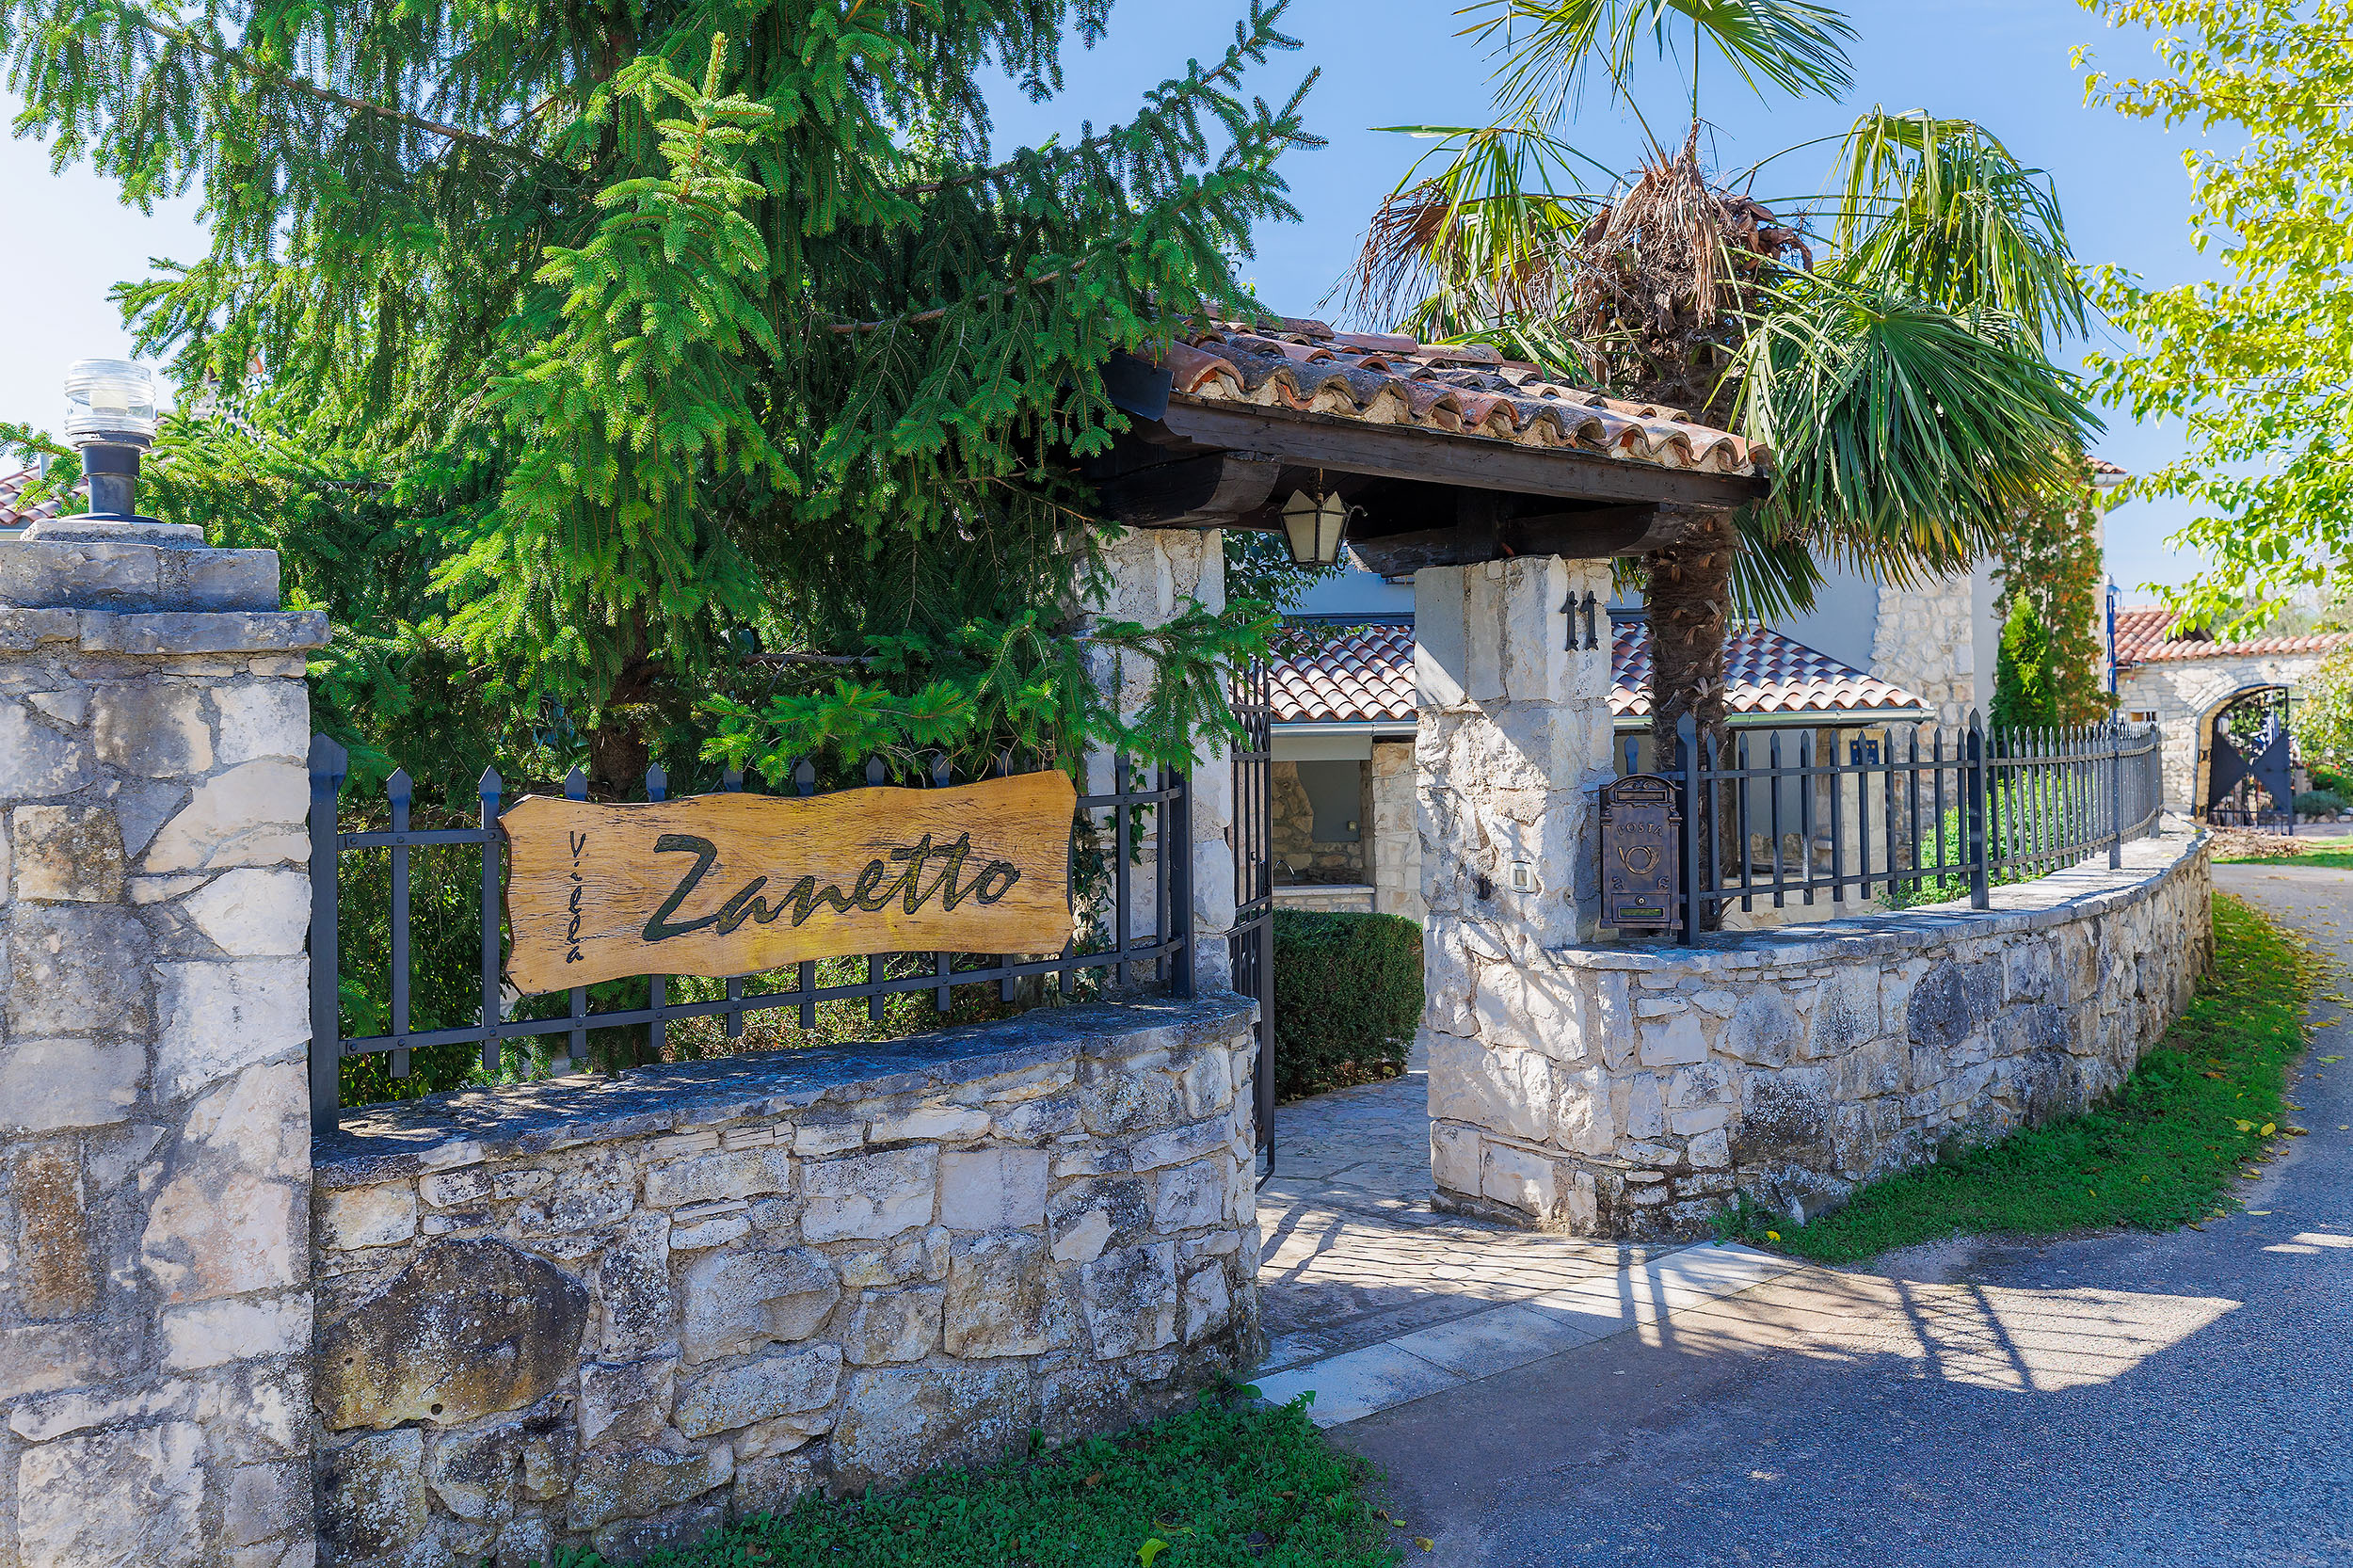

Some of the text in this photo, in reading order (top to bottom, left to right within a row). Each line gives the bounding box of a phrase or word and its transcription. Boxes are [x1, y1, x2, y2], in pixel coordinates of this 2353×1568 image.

[1560, 590, 1599, 651] 11
[1616, 822, 1663, 837] POSTA
[566, 830, 587, 964] Villa
[641, 833, 1021, 942] Zanetto
